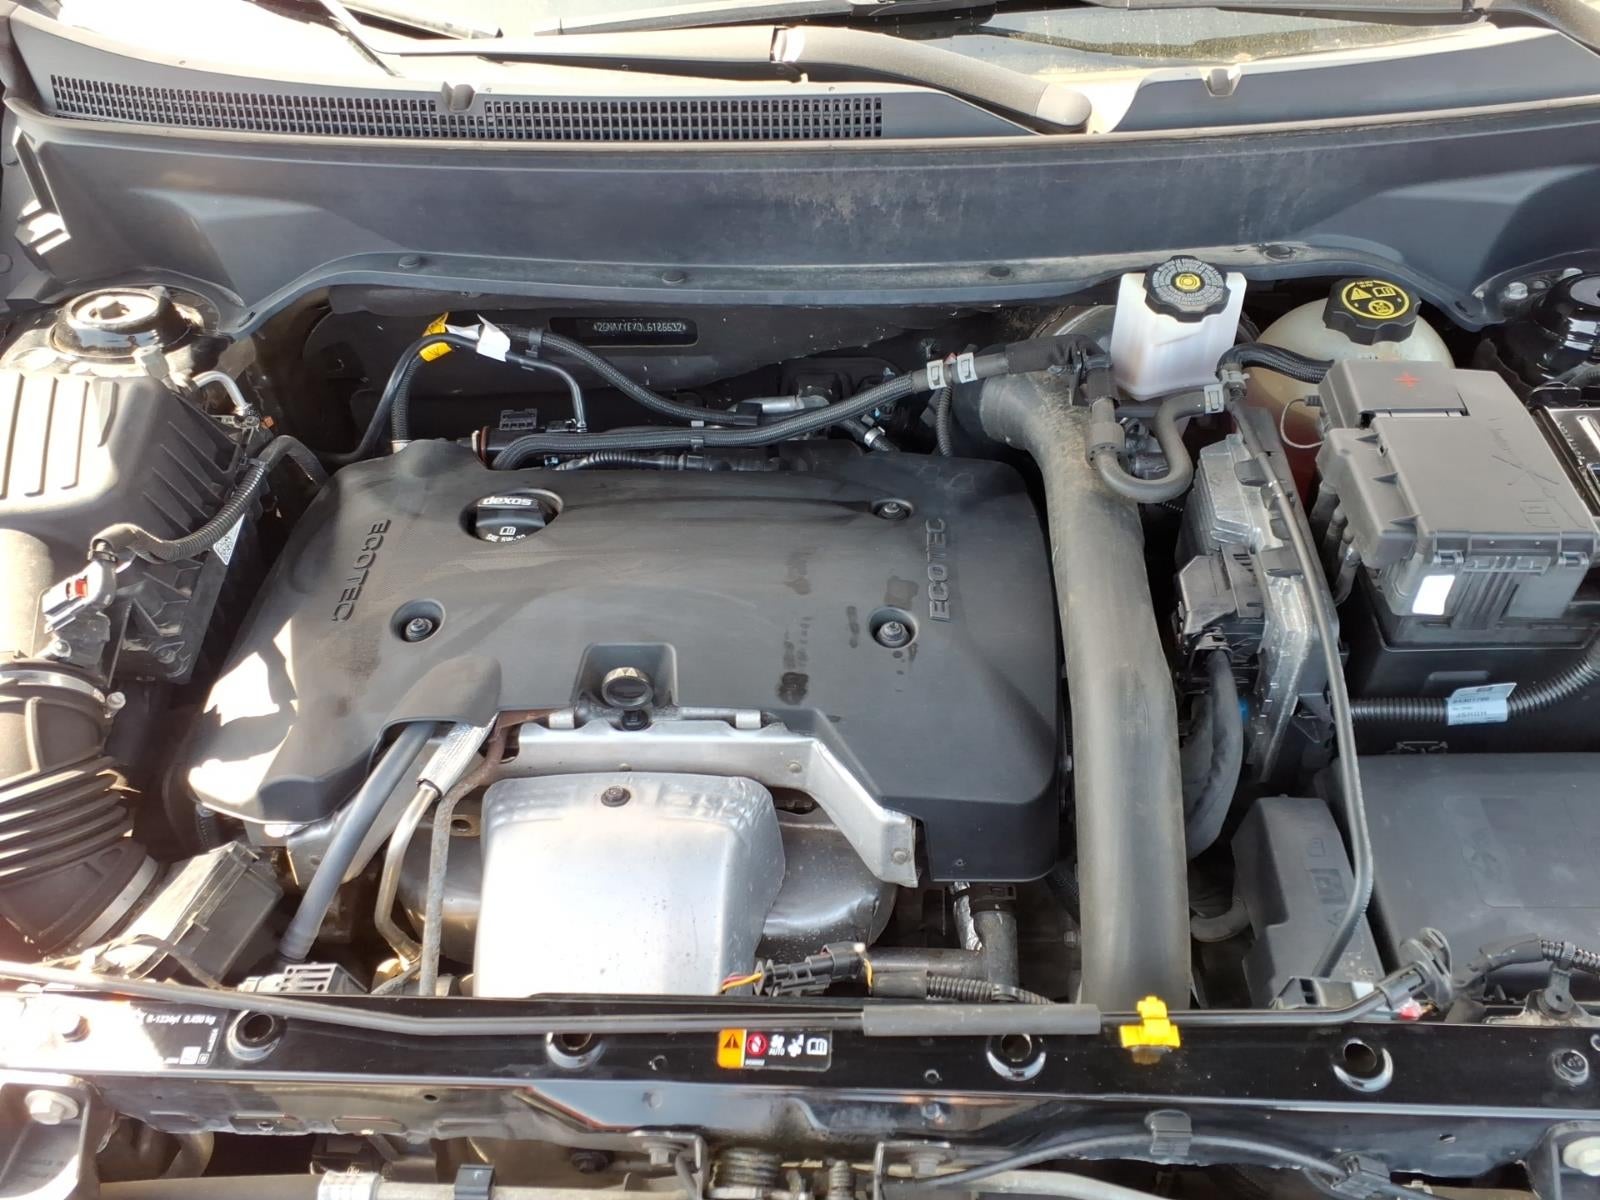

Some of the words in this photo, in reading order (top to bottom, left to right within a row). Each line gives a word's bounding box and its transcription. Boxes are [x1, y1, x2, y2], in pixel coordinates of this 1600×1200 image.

[482, 496, 533, 506] dexos
[485, 533, 499, 543] SAE
[331, 519, 392, 622] ECOTEC
[926, 518, 950, 620] ECOTEC
[768, 1048, 785, 1056] AUTO
